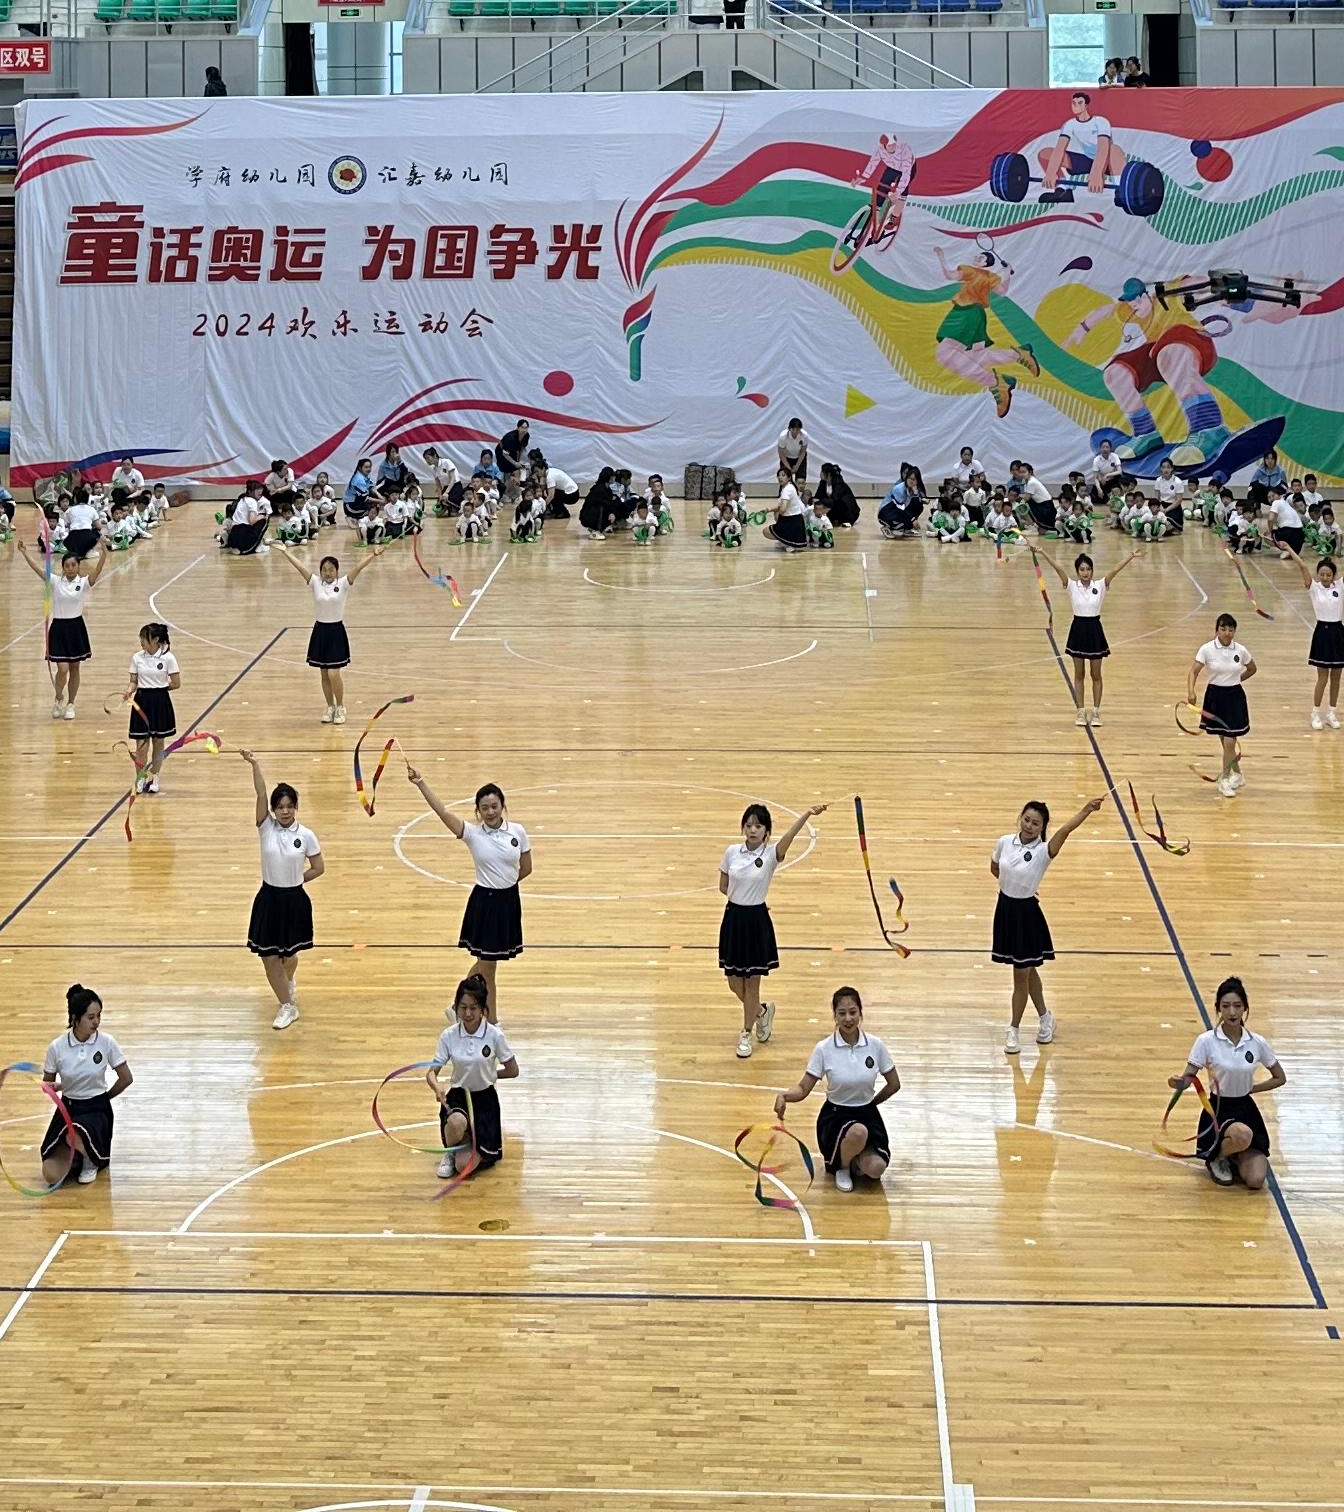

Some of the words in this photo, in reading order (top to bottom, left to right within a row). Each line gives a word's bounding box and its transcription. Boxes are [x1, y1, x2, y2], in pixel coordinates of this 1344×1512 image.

[184, 164, 316, 188] 学府幼儿园
[377, 163, 510, 188] 汇嘉幼儿园
[57, 200, 327, 285] 童话奥运
[359, 223, 604, 282] 为国争光
[192, 308, 495, 341] 2024欢乐运动会
